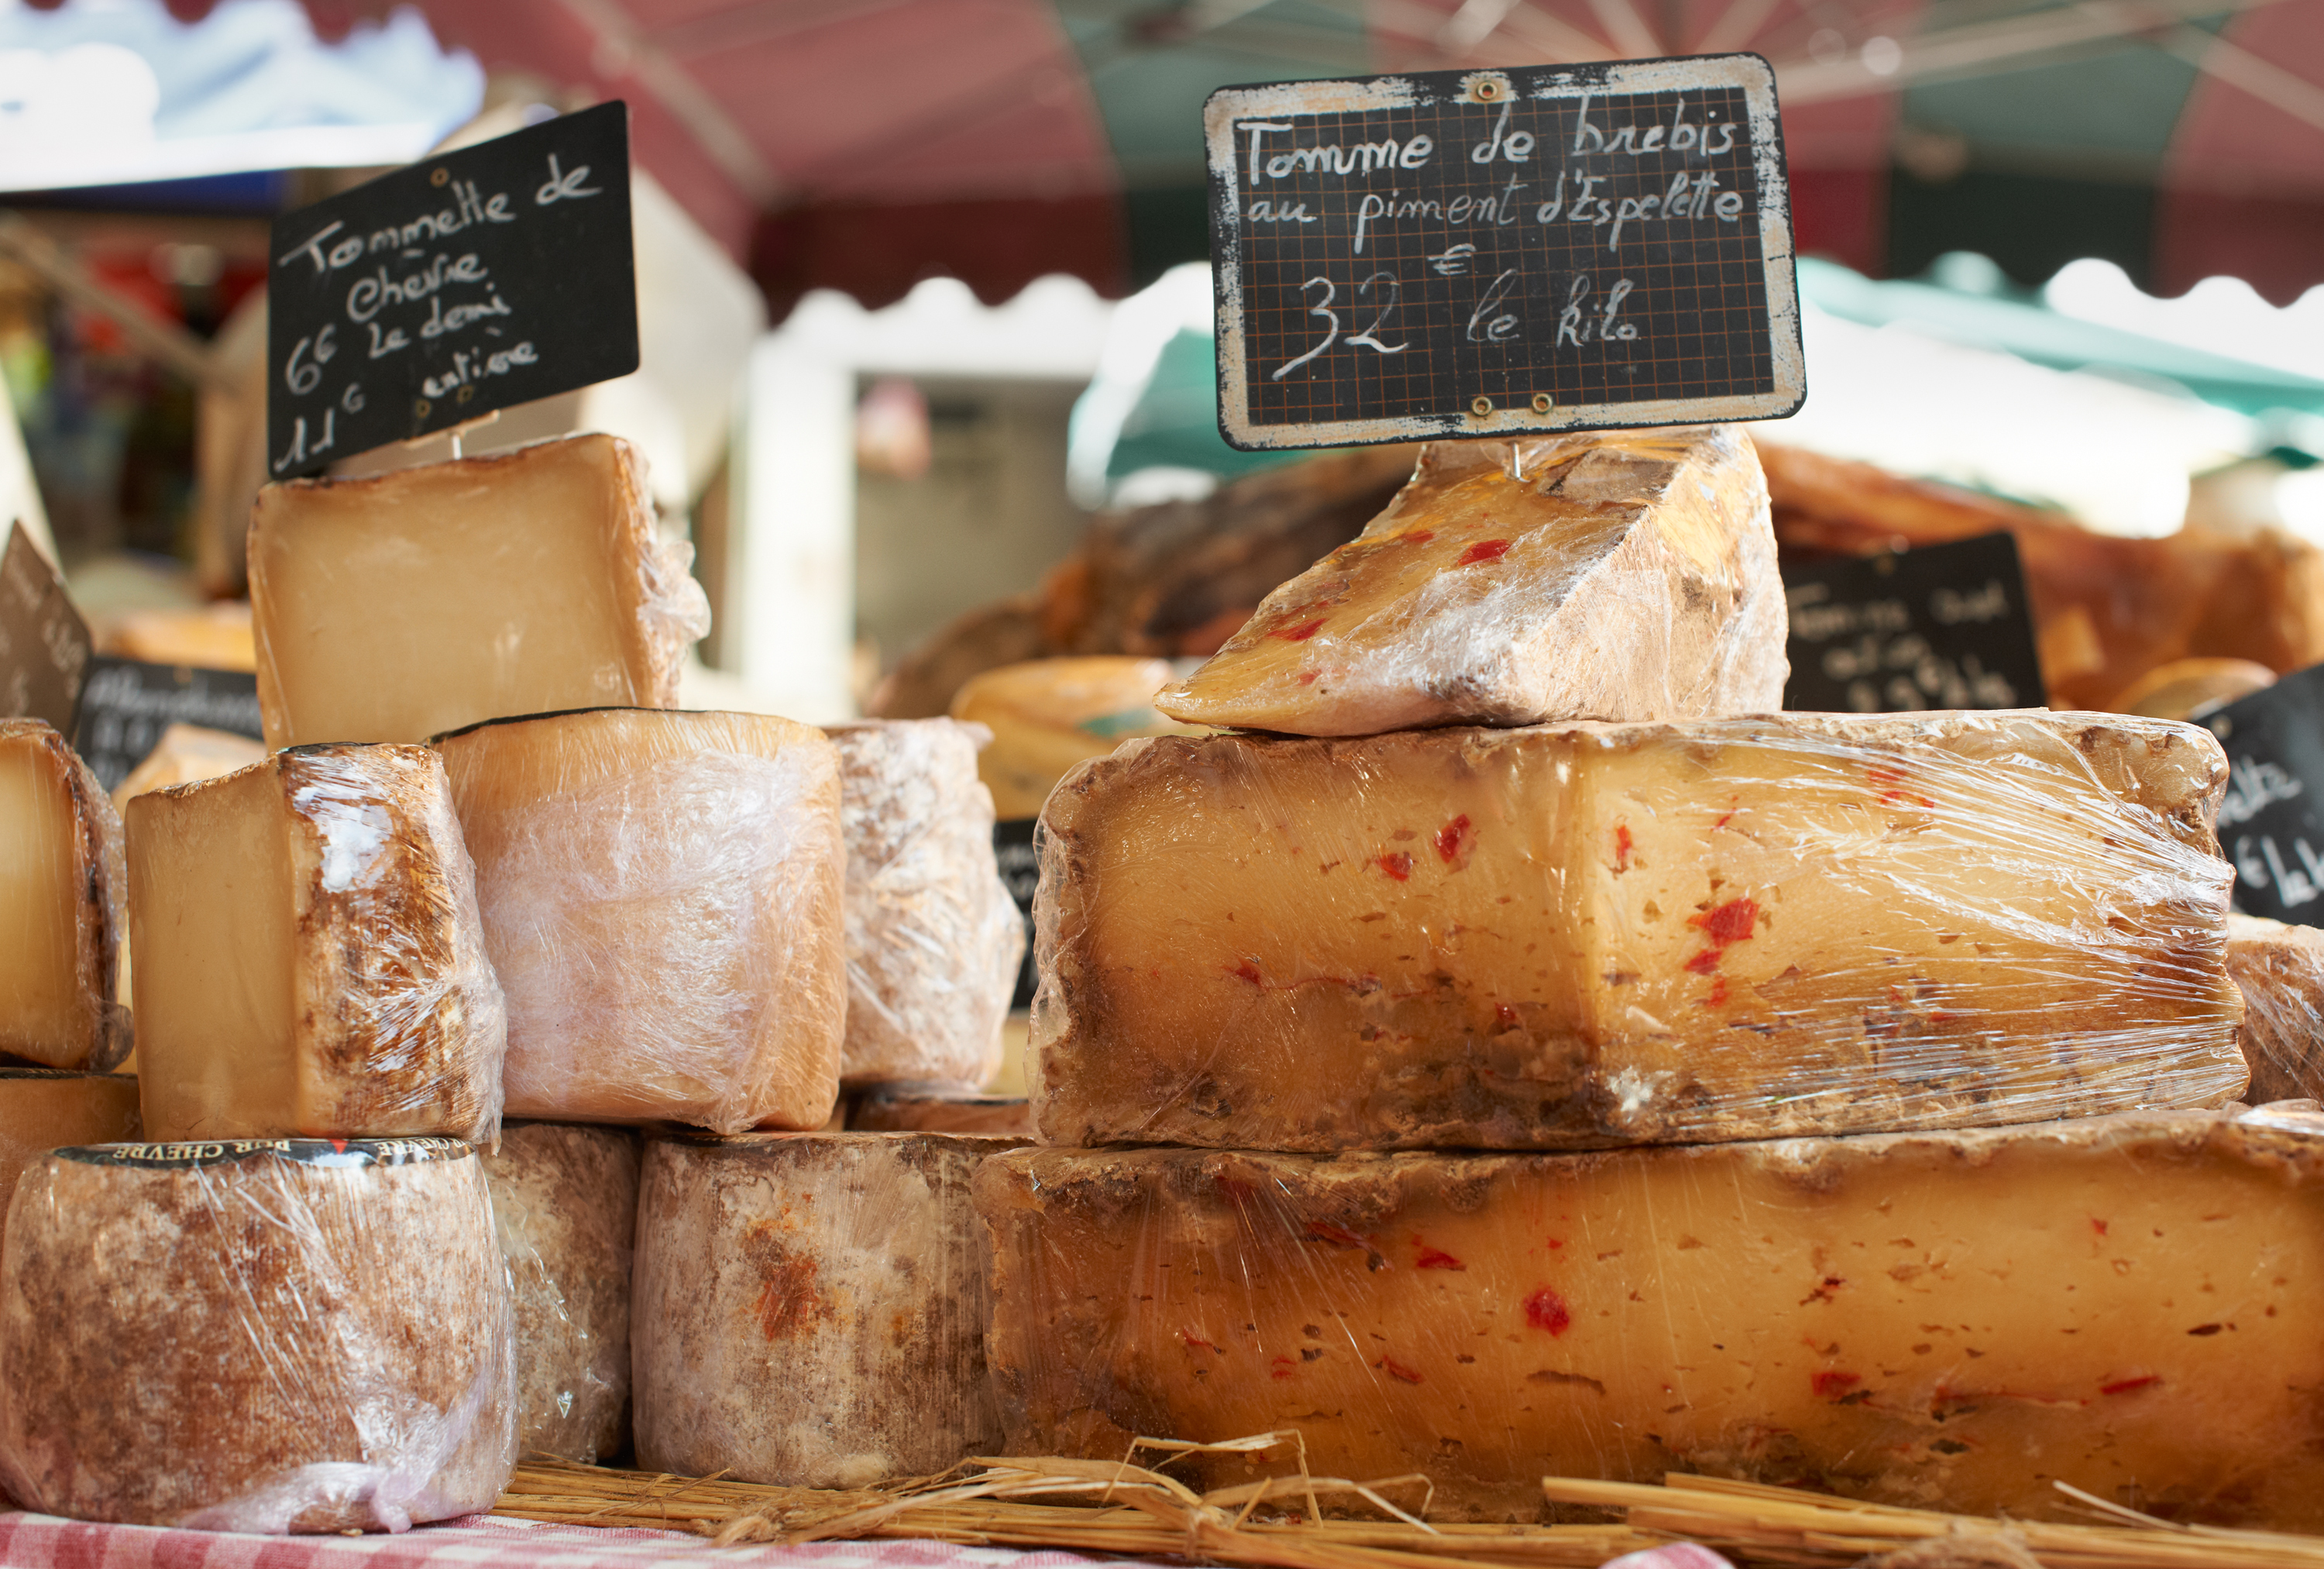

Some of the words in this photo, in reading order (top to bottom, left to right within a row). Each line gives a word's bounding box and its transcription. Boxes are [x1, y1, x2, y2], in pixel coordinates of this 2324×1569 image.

[1237, 121, 1433, 186] Tomme
[1471, 101, 1535, 164] de
[1571, 94, 1738, 158] brebis
[278, 180, 517, 273] Tommette
[535, 153, 603, 205] de
[1247, 198, 1317, 223] au
[1354, 172, 1528, 254] piment
[1535, 169, 1744, 253] d'Espelette
[420, 282, 512, 339] demi
[1467, 267, 1519, 342] le
[112, 1144, 225, 1161] CHEVRE
